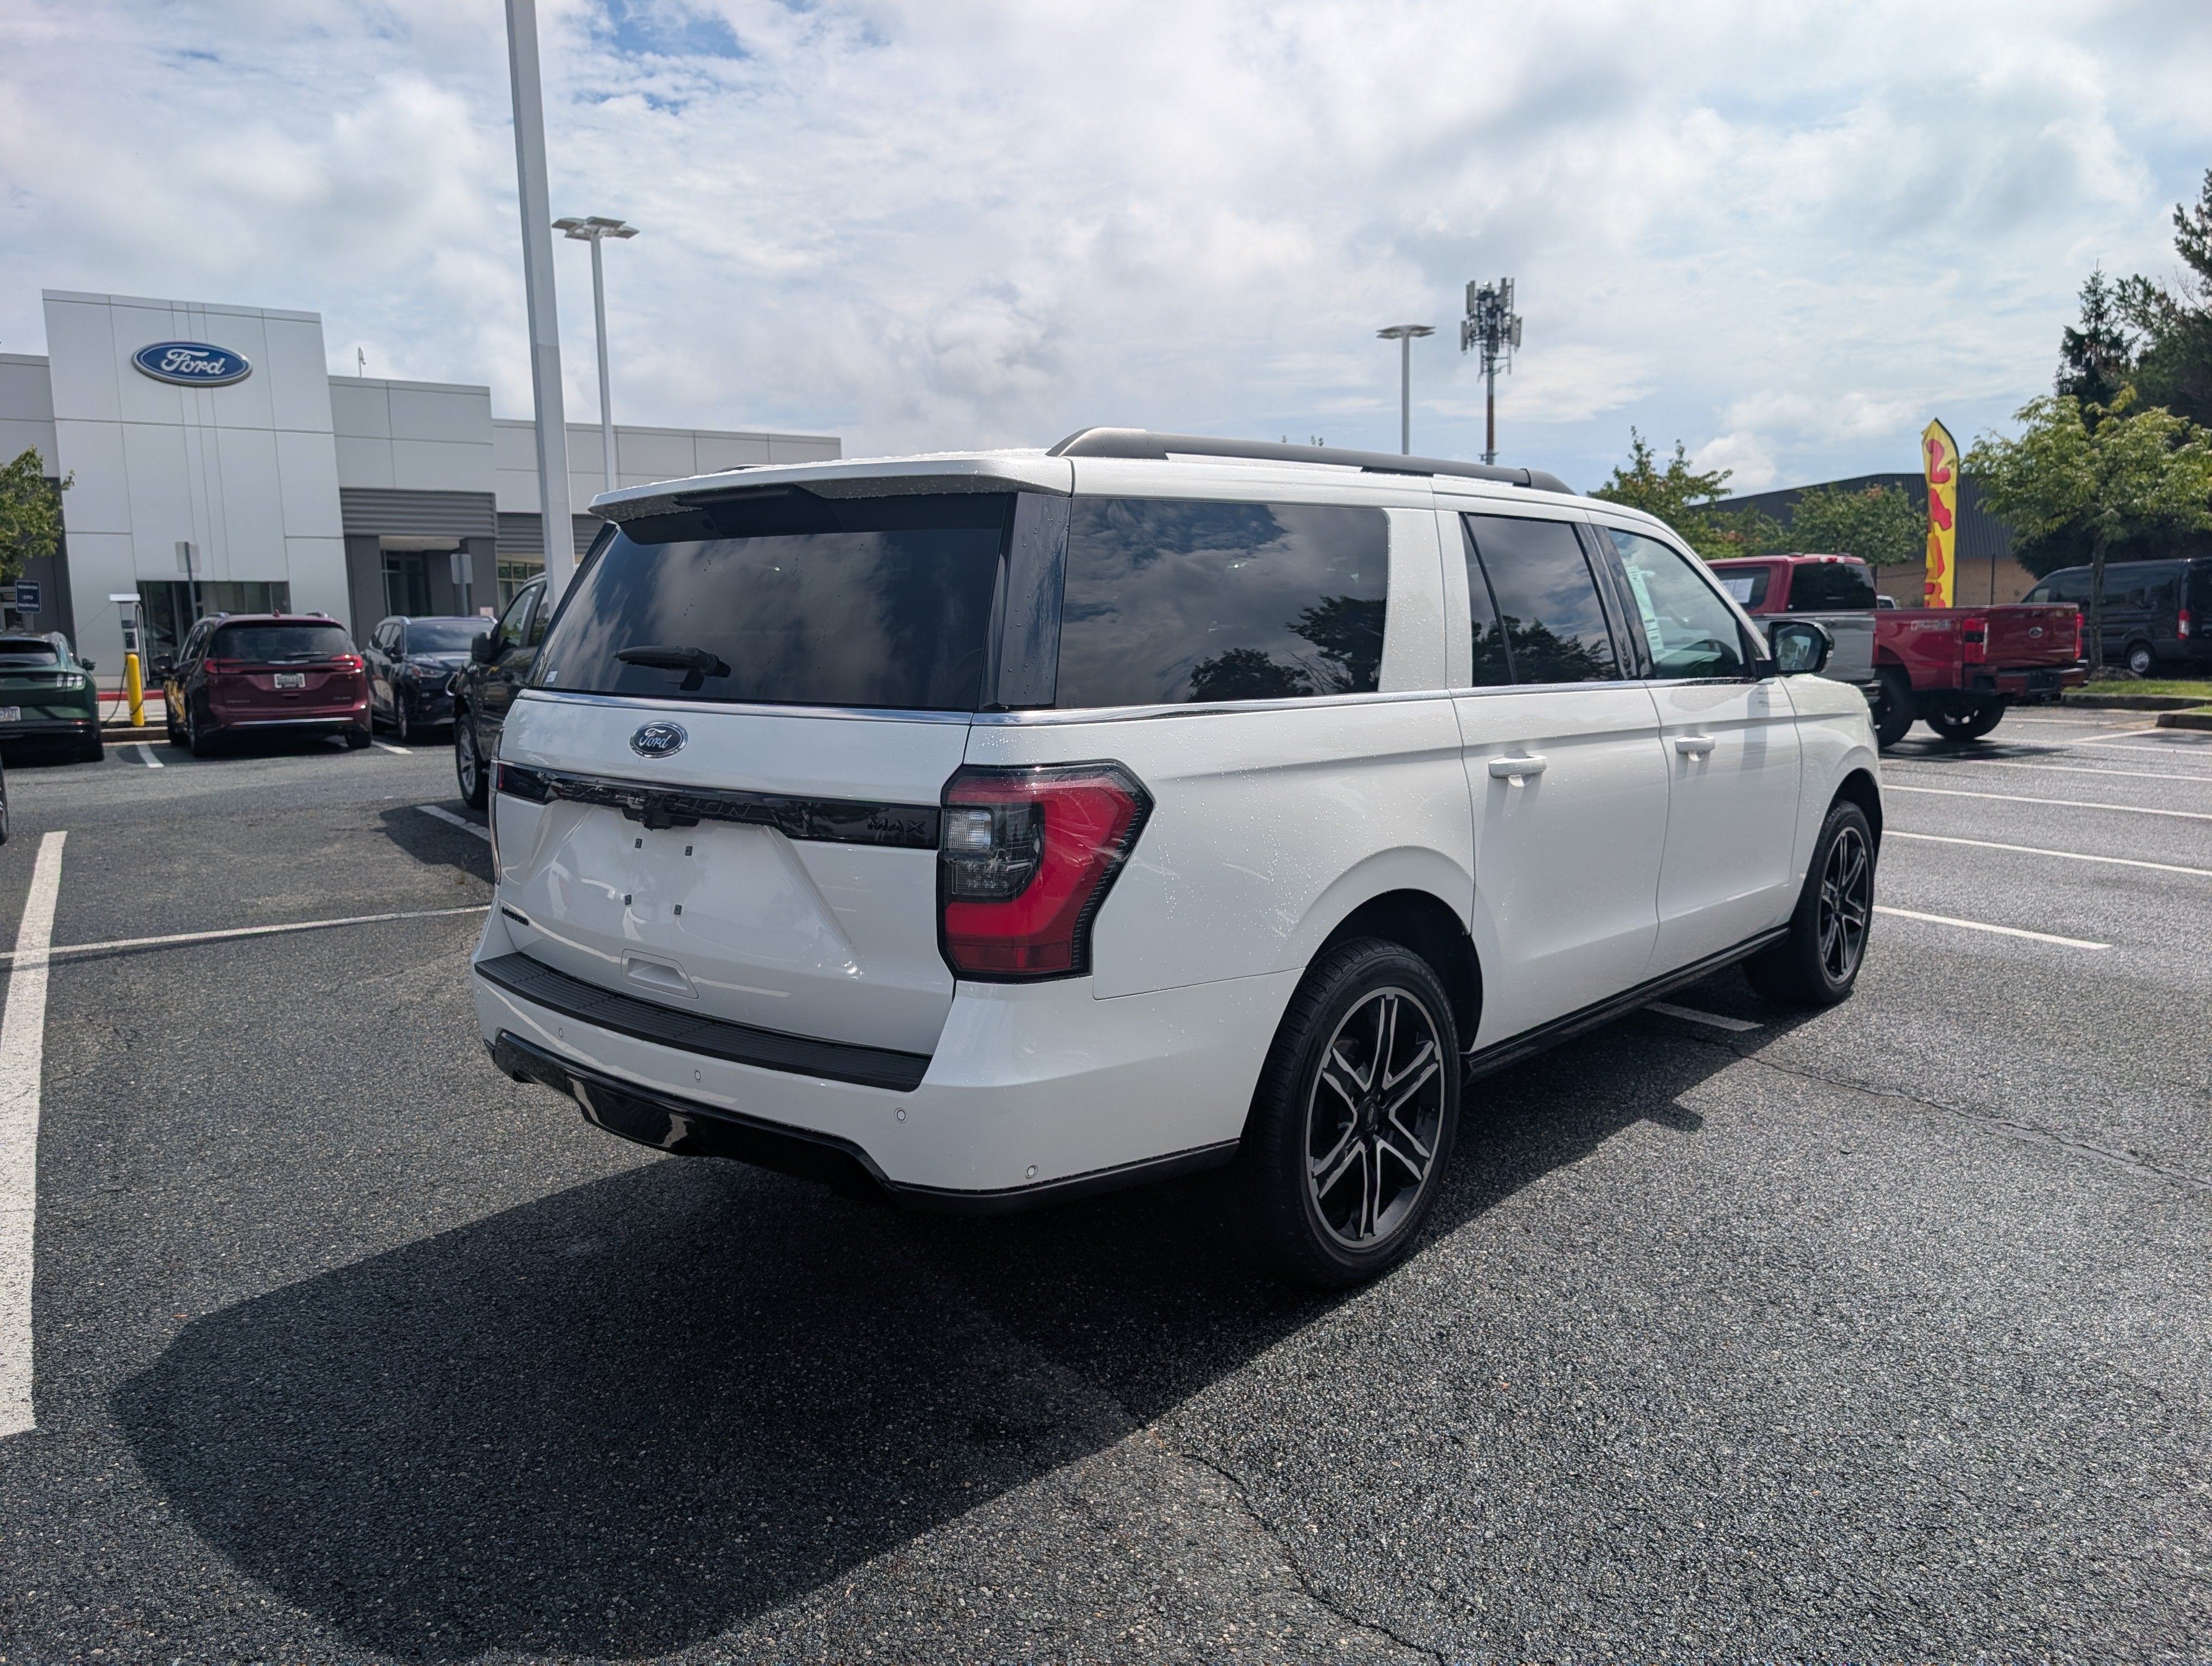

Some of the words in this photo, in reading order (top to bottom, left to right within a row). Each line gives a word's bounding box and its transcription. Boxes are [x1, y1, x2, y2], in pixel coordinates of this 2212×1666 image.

[161, 348, 226, 375] Ford
[639, 728, 672, 749] Ford
[867, 817, 927, 835] MAX
